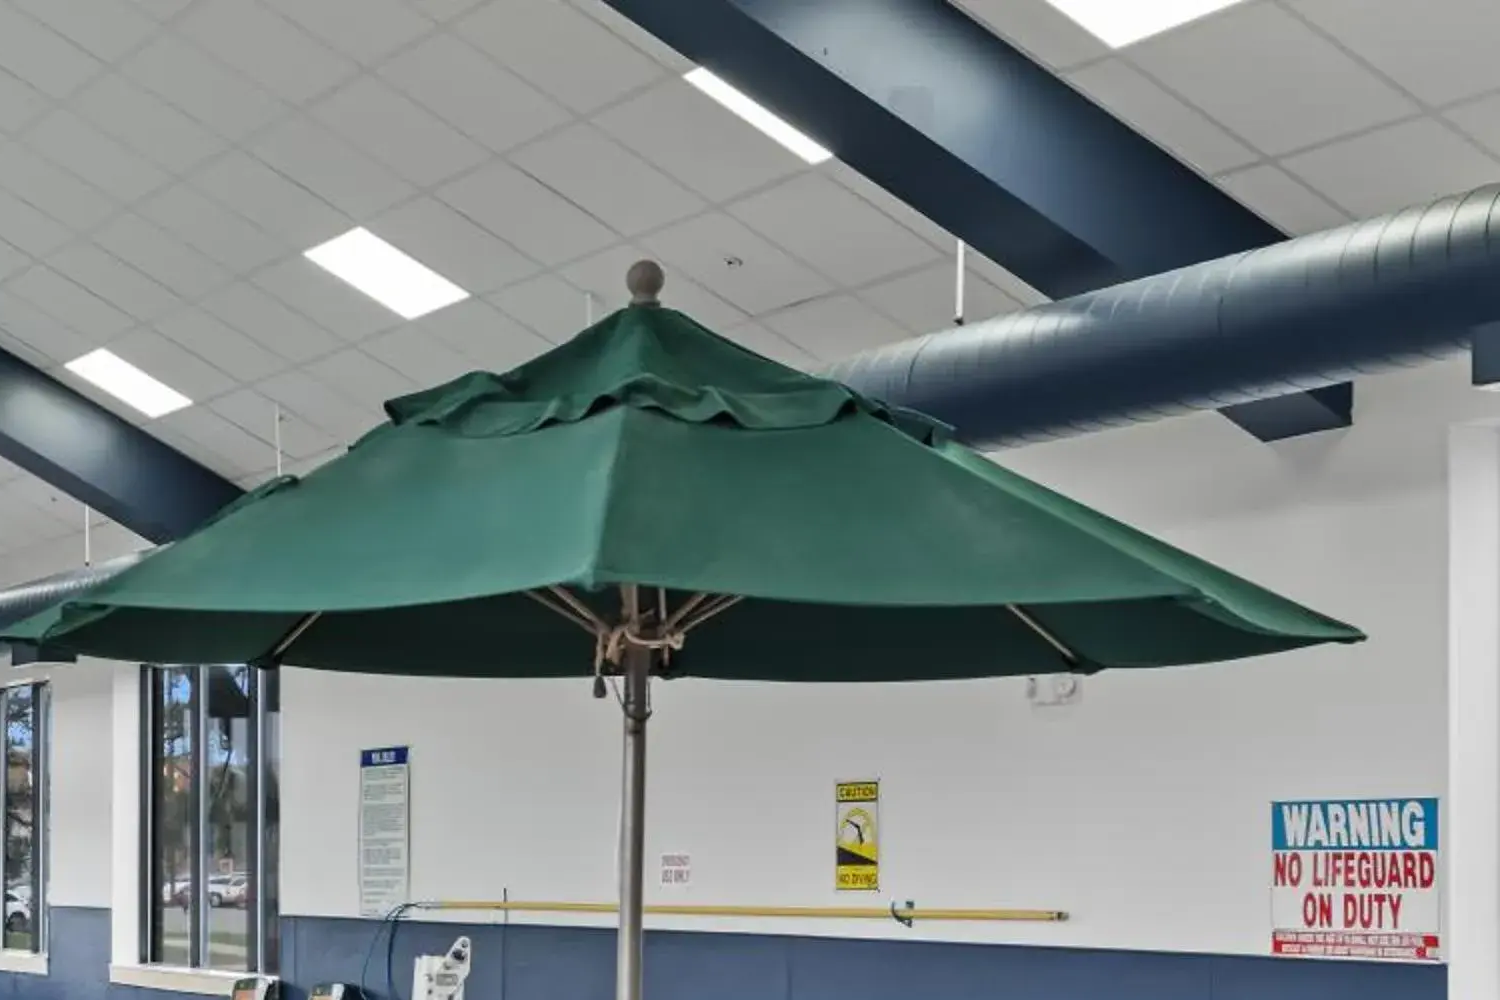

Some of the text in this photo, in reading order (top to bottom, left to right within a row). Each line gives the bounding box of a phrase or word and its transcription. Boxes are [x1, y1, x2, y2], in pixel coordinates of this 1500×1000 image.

[1282, 801, 1425, 848] WARNING
[1273, 852, 1434, 888] NO LIFEGUARD
[1303, 893, 1402, 929] ON DUTY
